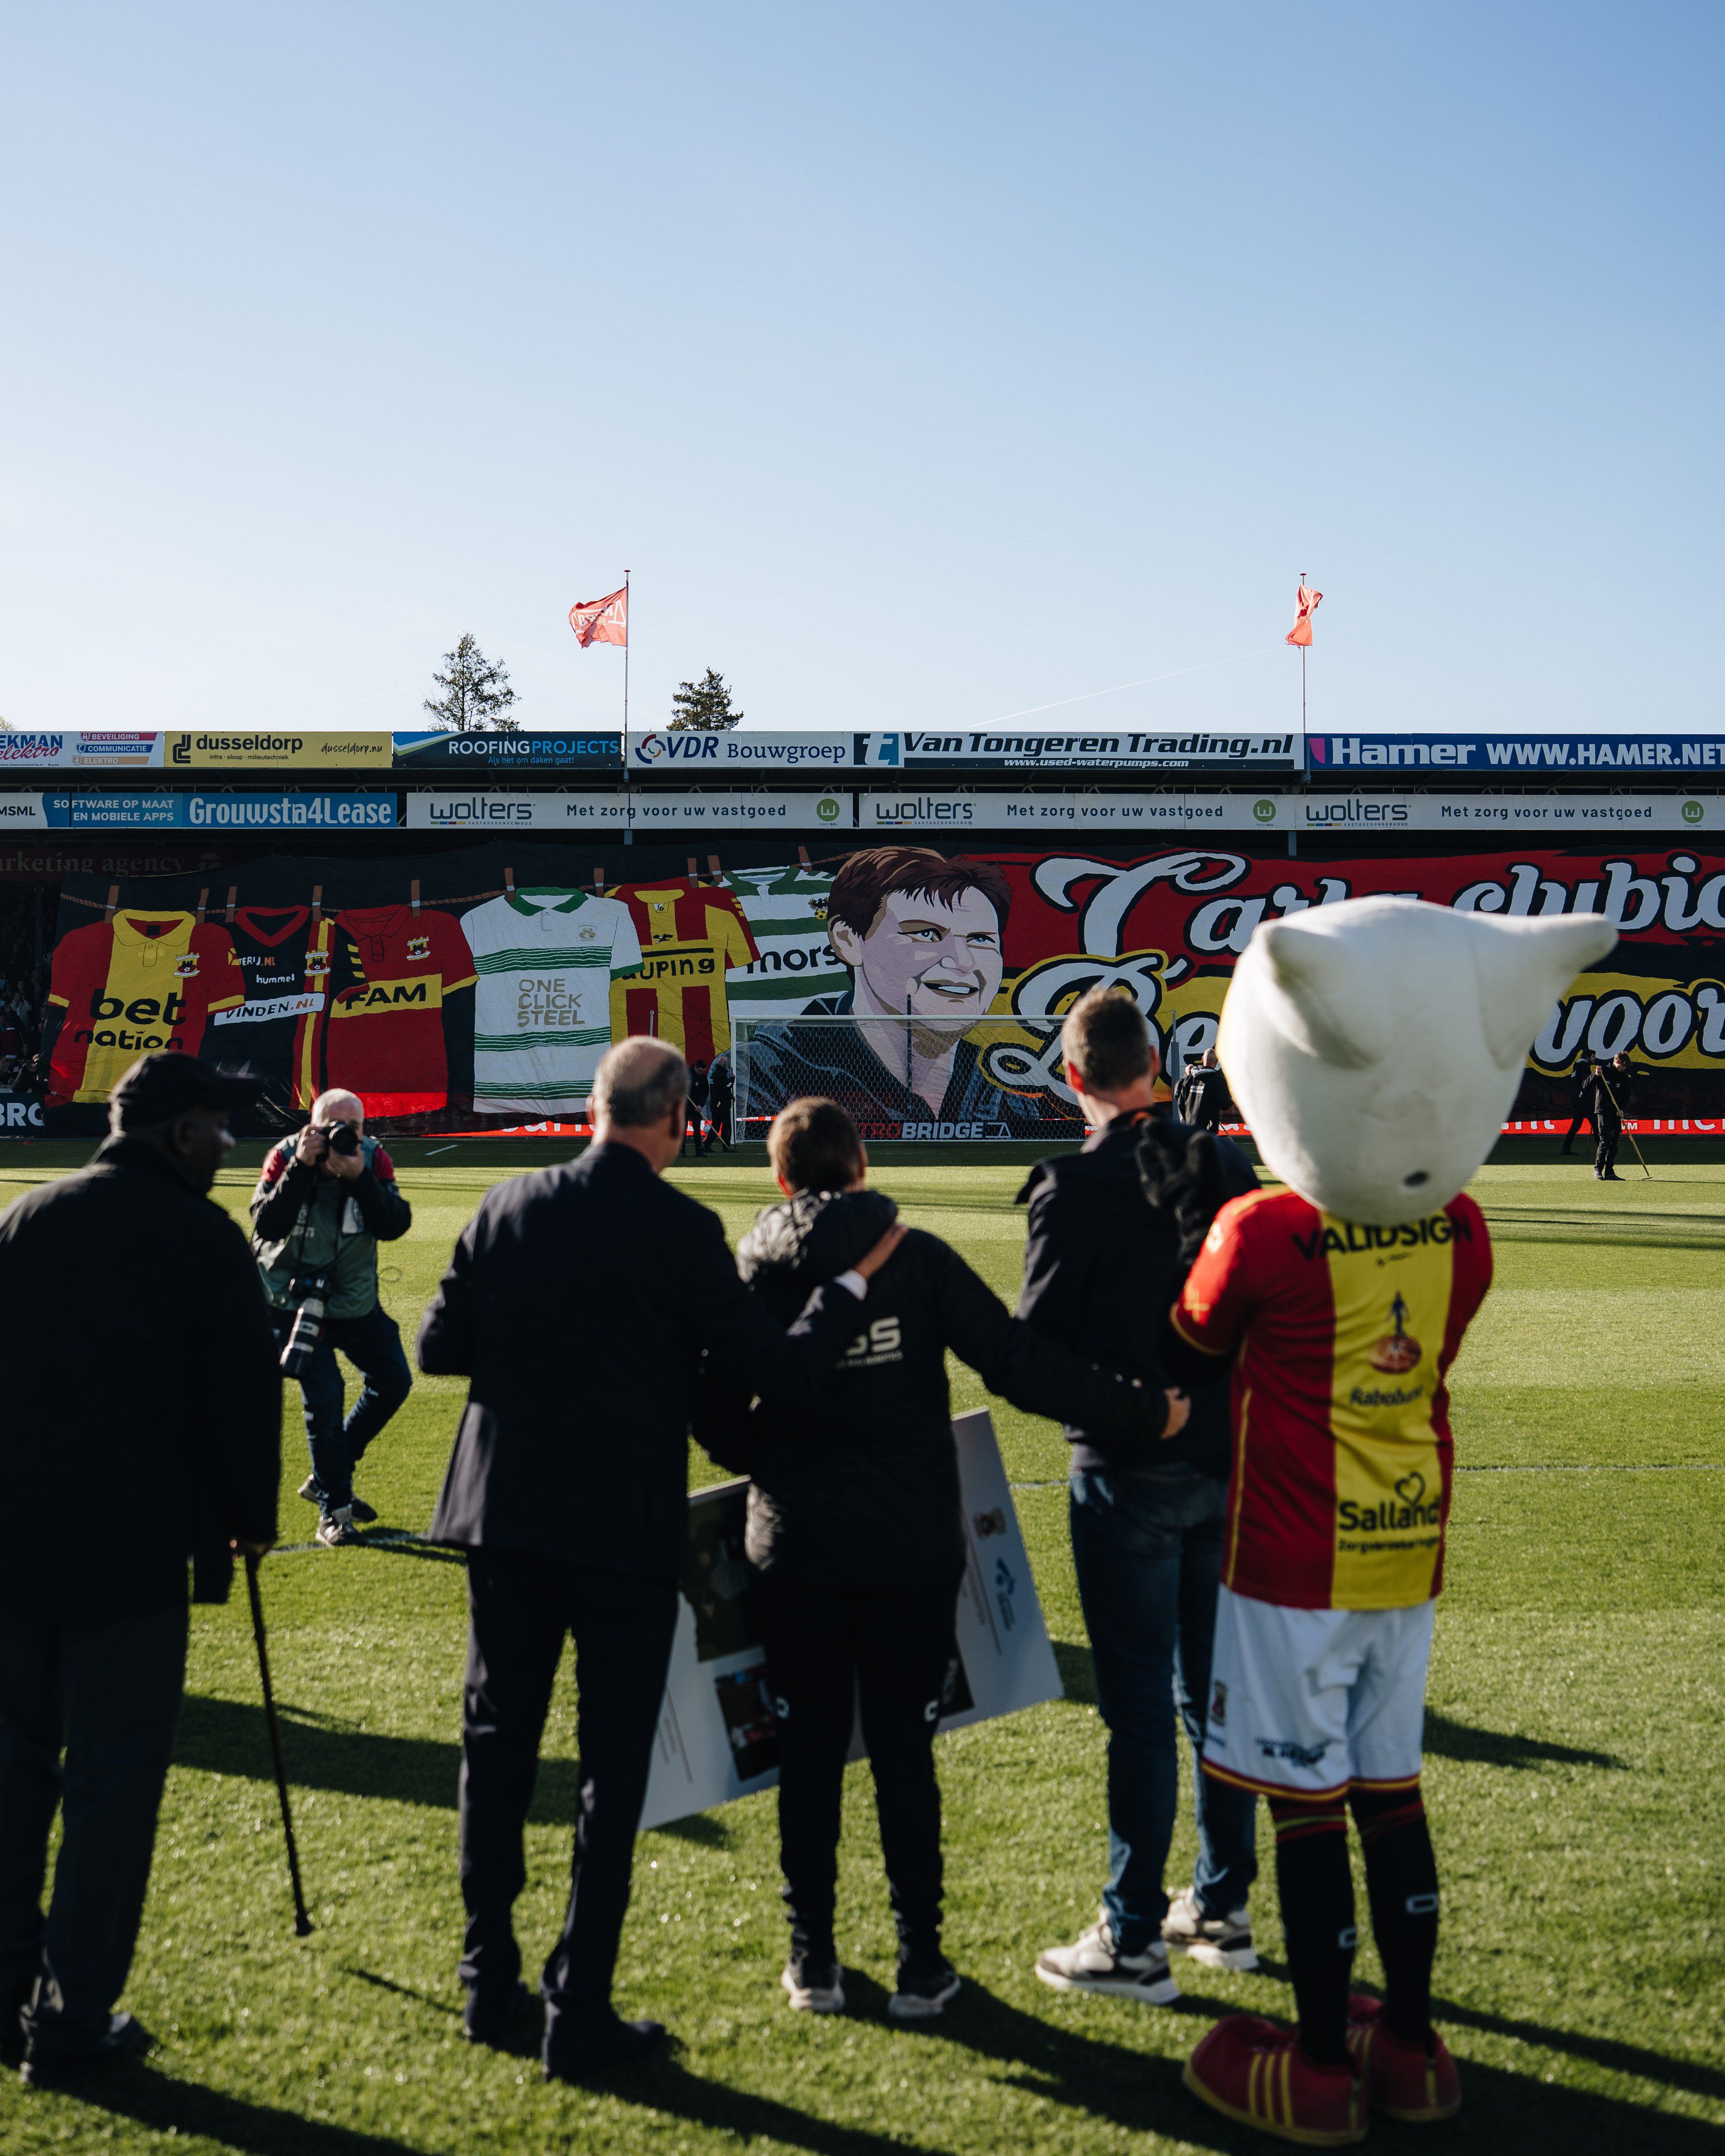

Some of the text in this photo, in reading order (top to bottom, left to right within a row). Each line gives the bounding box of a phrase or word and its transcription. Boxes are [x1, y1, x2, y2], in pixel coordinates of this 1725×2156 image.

[196, 735, 303, 754] dusseldorp
[321, 743, 383, 755] dusseldorp.nu
[448, 740, 619, 754] ROOFINGPROJECTS
[666, 736, 846, 764] VDR Bouwgroep
[903, 732, 1294, 758] Van Tongeren Trading.nl
[1331, 737, 1725, 765] Hamer WWW.HAMER.NET
[487, 756, 500, 764] Als
[555, 756, 575, 766] gaat!
[1004, 758, 1189, 768] www.used-waterpumps.com
[53, 800, 174, 808] SOFTWARE OP MAAT
[190, 797, 392, 824] Grouwsta4Lease
[430, 796, 532, 820] wolters
[566, 804, 786, 820] Met zorg voor uw vastgoed
[876, 796, 973, 820] wolters
[1007, 804, 1223, 820] Met zorg voor uw vastgoed
[1306, 798, 1408, 821] wolters
[1441, 805, 1652, 820] Met zorg voor uw vastgoed
[73, 812, 174, 821] EN MOBIELE APPS
[102, 859, 188, 876] agency
[256, 973, 295, 984] hummel
[519, 978, 566, 993] ONE
[89, 988, 187, 1026] bet
[518, 992, 583, 1010] CLICK
[517, 1010, 585, 1028] STEEL
[74, 1030, 184, 1051] nation
[1291, 1213, 1473, 1261] VALIDSIGN
